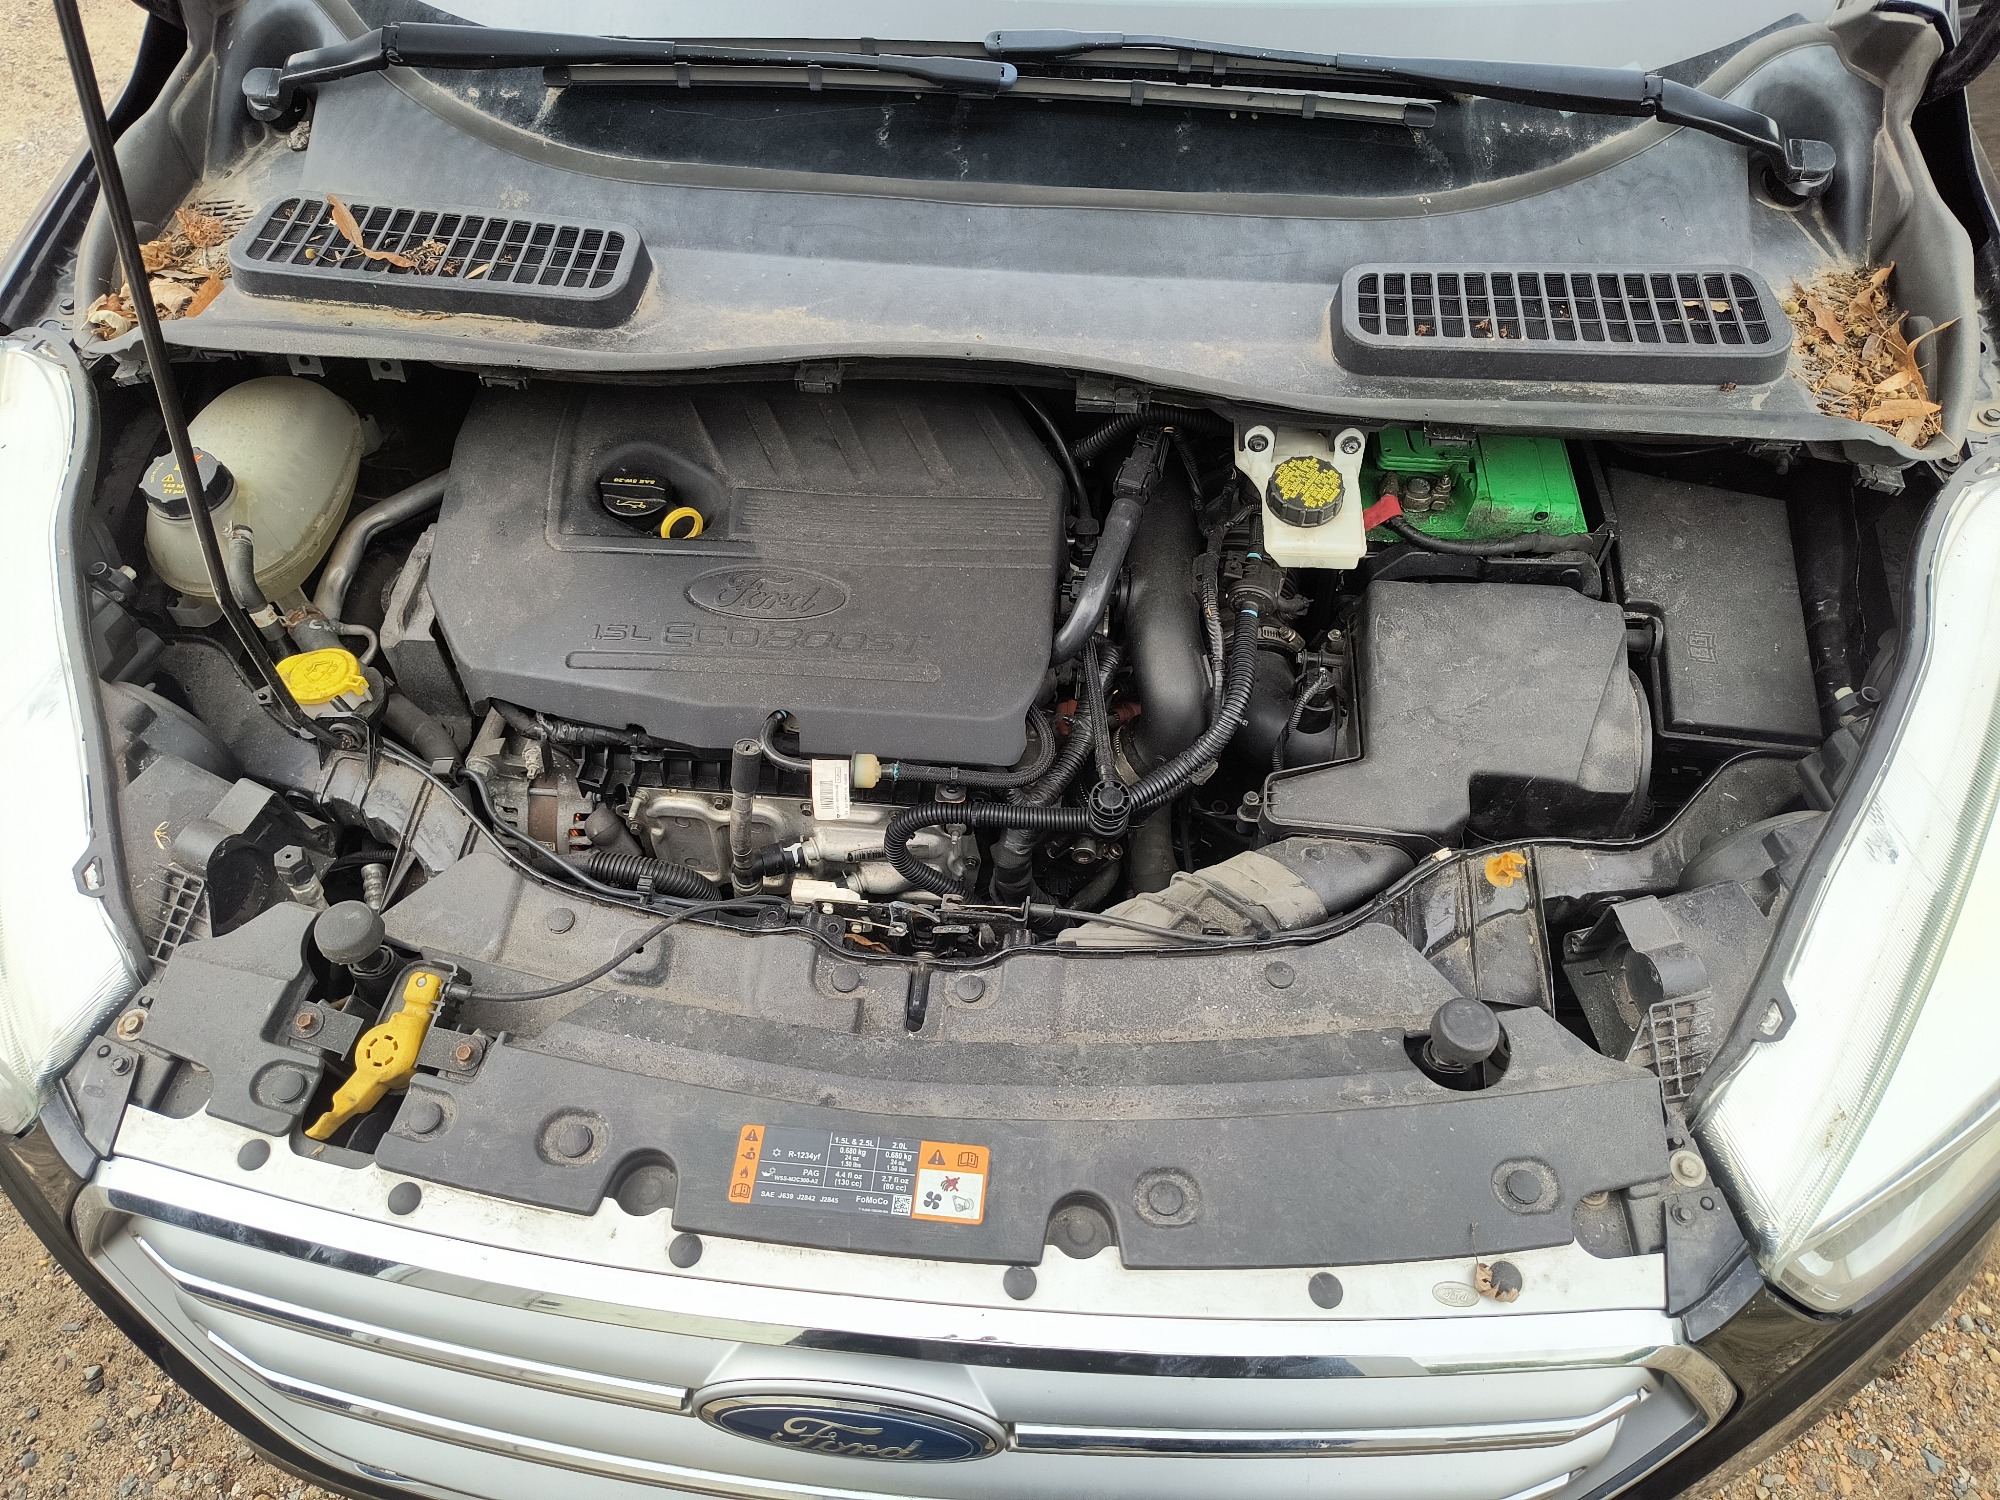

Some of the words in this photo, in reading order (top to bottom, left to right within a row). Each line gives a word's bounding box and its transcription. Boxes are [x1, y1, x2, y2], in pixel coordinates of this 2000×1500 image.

[716, 575, 821, 613] Ford
[892, 1142, 907, 1150] 2.0L
[788, 1150, 821, 1161] R-1234yf
[858, 1149, 866, 1157] kg
[885, 1151, 902, 1159] 0.680
[835, 1170, 845, 1178] 4.4
[834, 1179, 850, 1187] (130
[851, 1180, 862, 1188] cc)
[856, 1195, 888, 1205] FoMoCo
[770, 1416, 923, 1460] Ford
